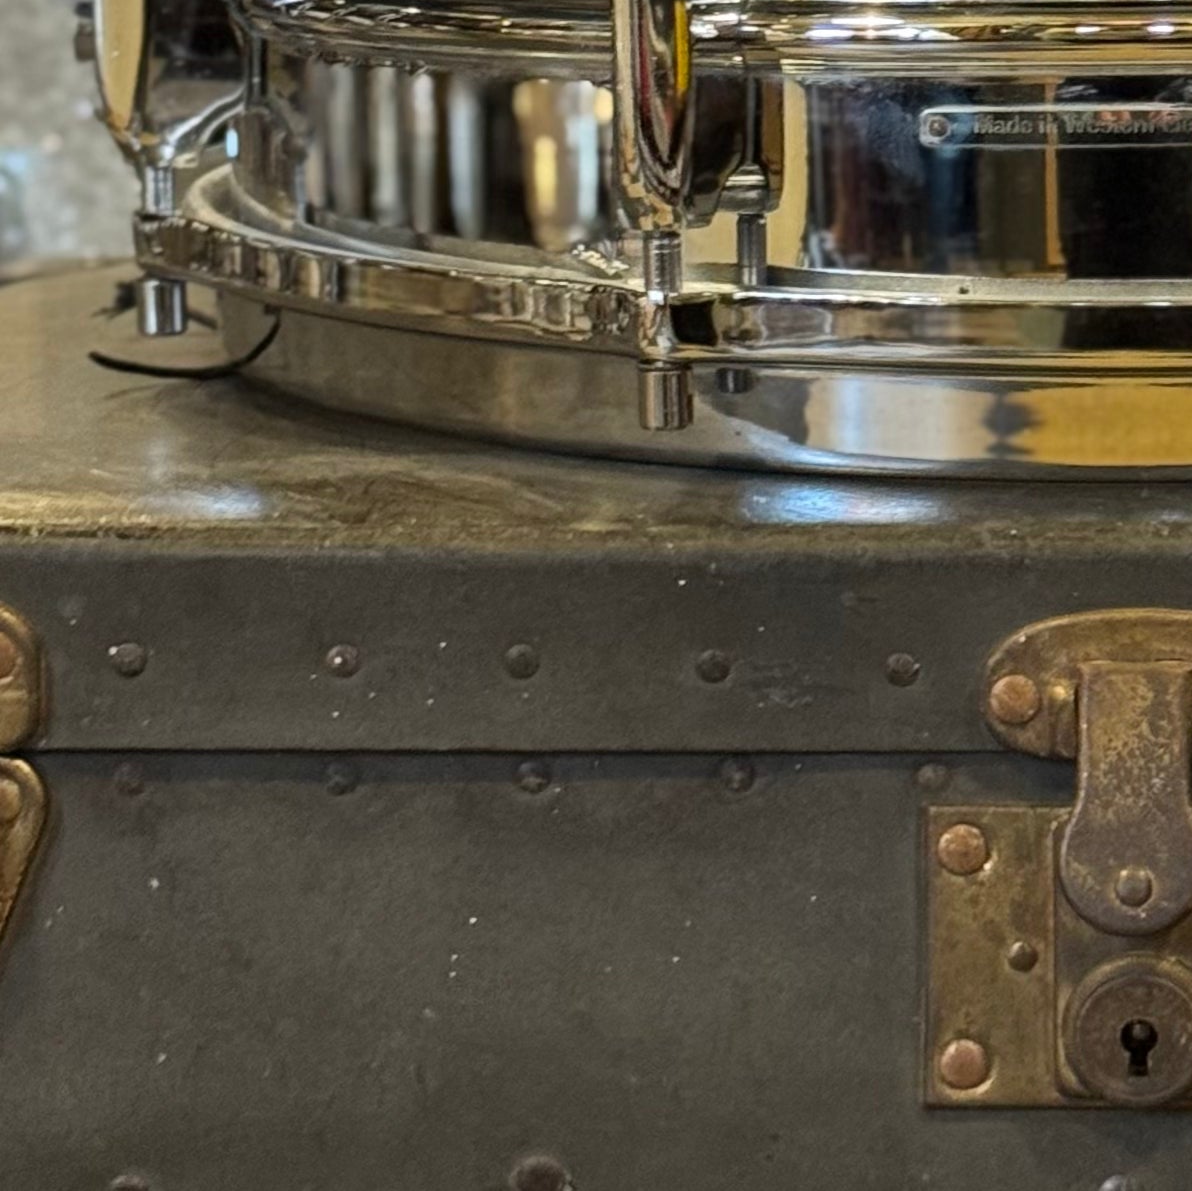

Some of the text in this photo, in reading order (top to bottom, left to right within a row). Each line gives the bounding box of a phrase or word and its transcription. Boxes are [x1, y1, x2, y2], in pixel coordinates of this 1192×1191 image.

[973, 112, 1034, 135] Made
[1037, 112, 1059, 135] in
[1061, 111, 1156, 135] Western
